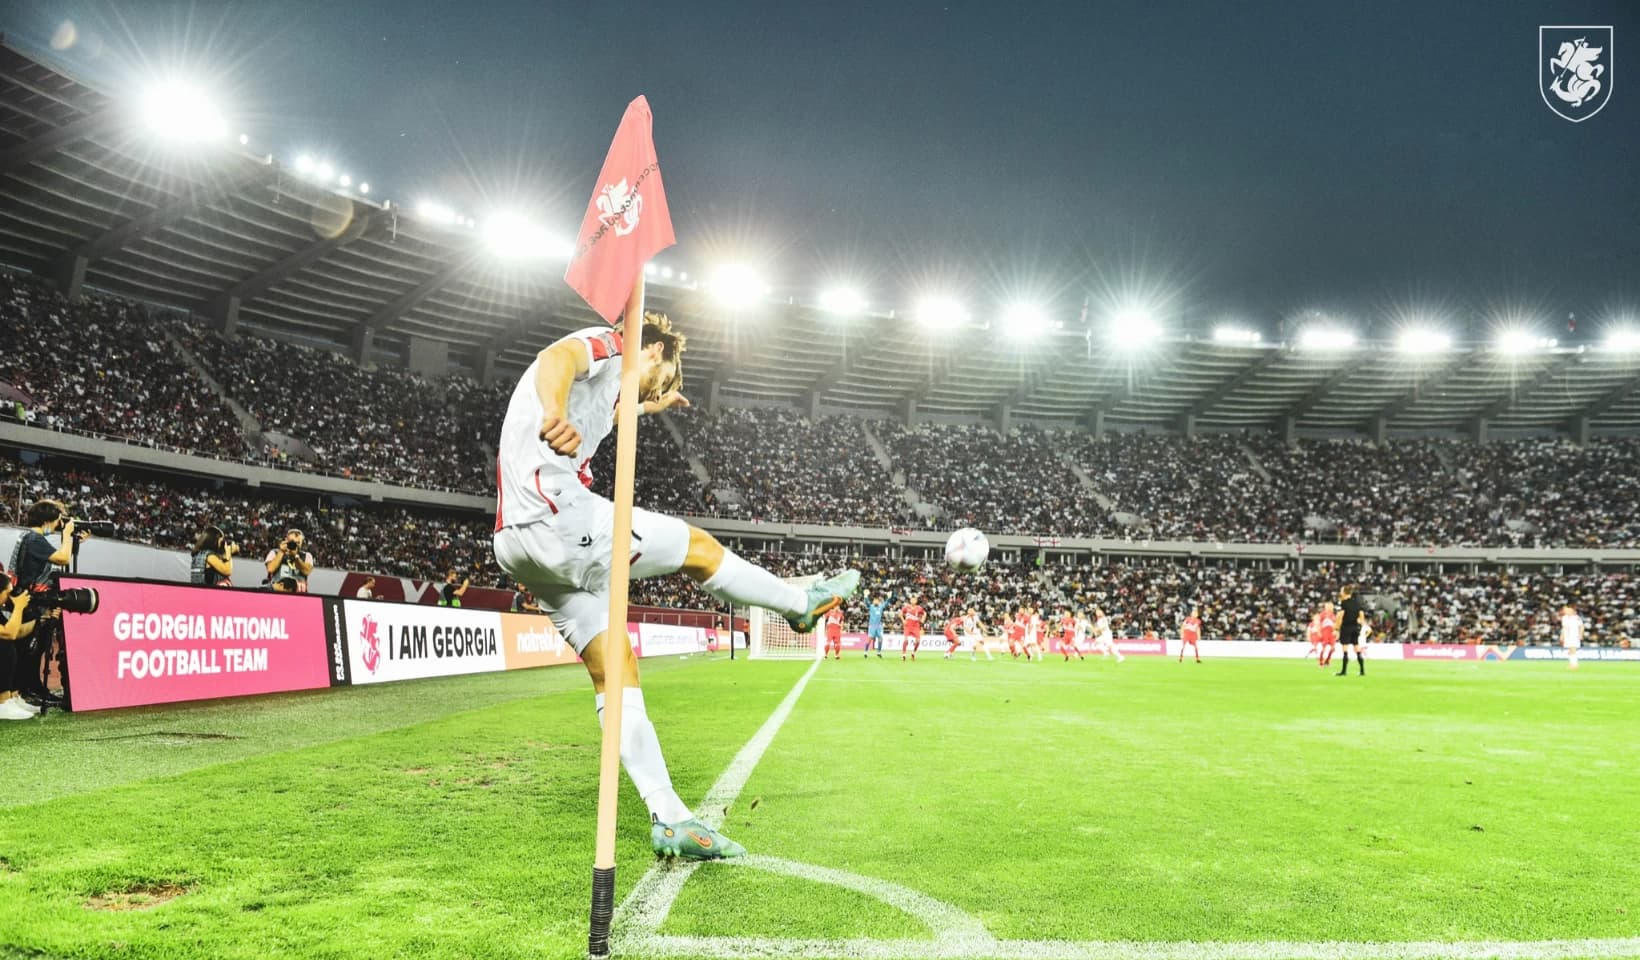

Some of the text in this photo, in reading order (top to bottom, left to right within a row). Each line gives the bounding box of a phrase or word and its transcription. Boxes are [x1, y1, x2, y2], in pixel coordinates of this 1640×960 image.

[113, 612, 289, 640] GEORGIA NATIONAL
[388, 624, 497, 660] I AM GEORGIA
[117, 648, 269, 679] FOOTBALL TEAM
